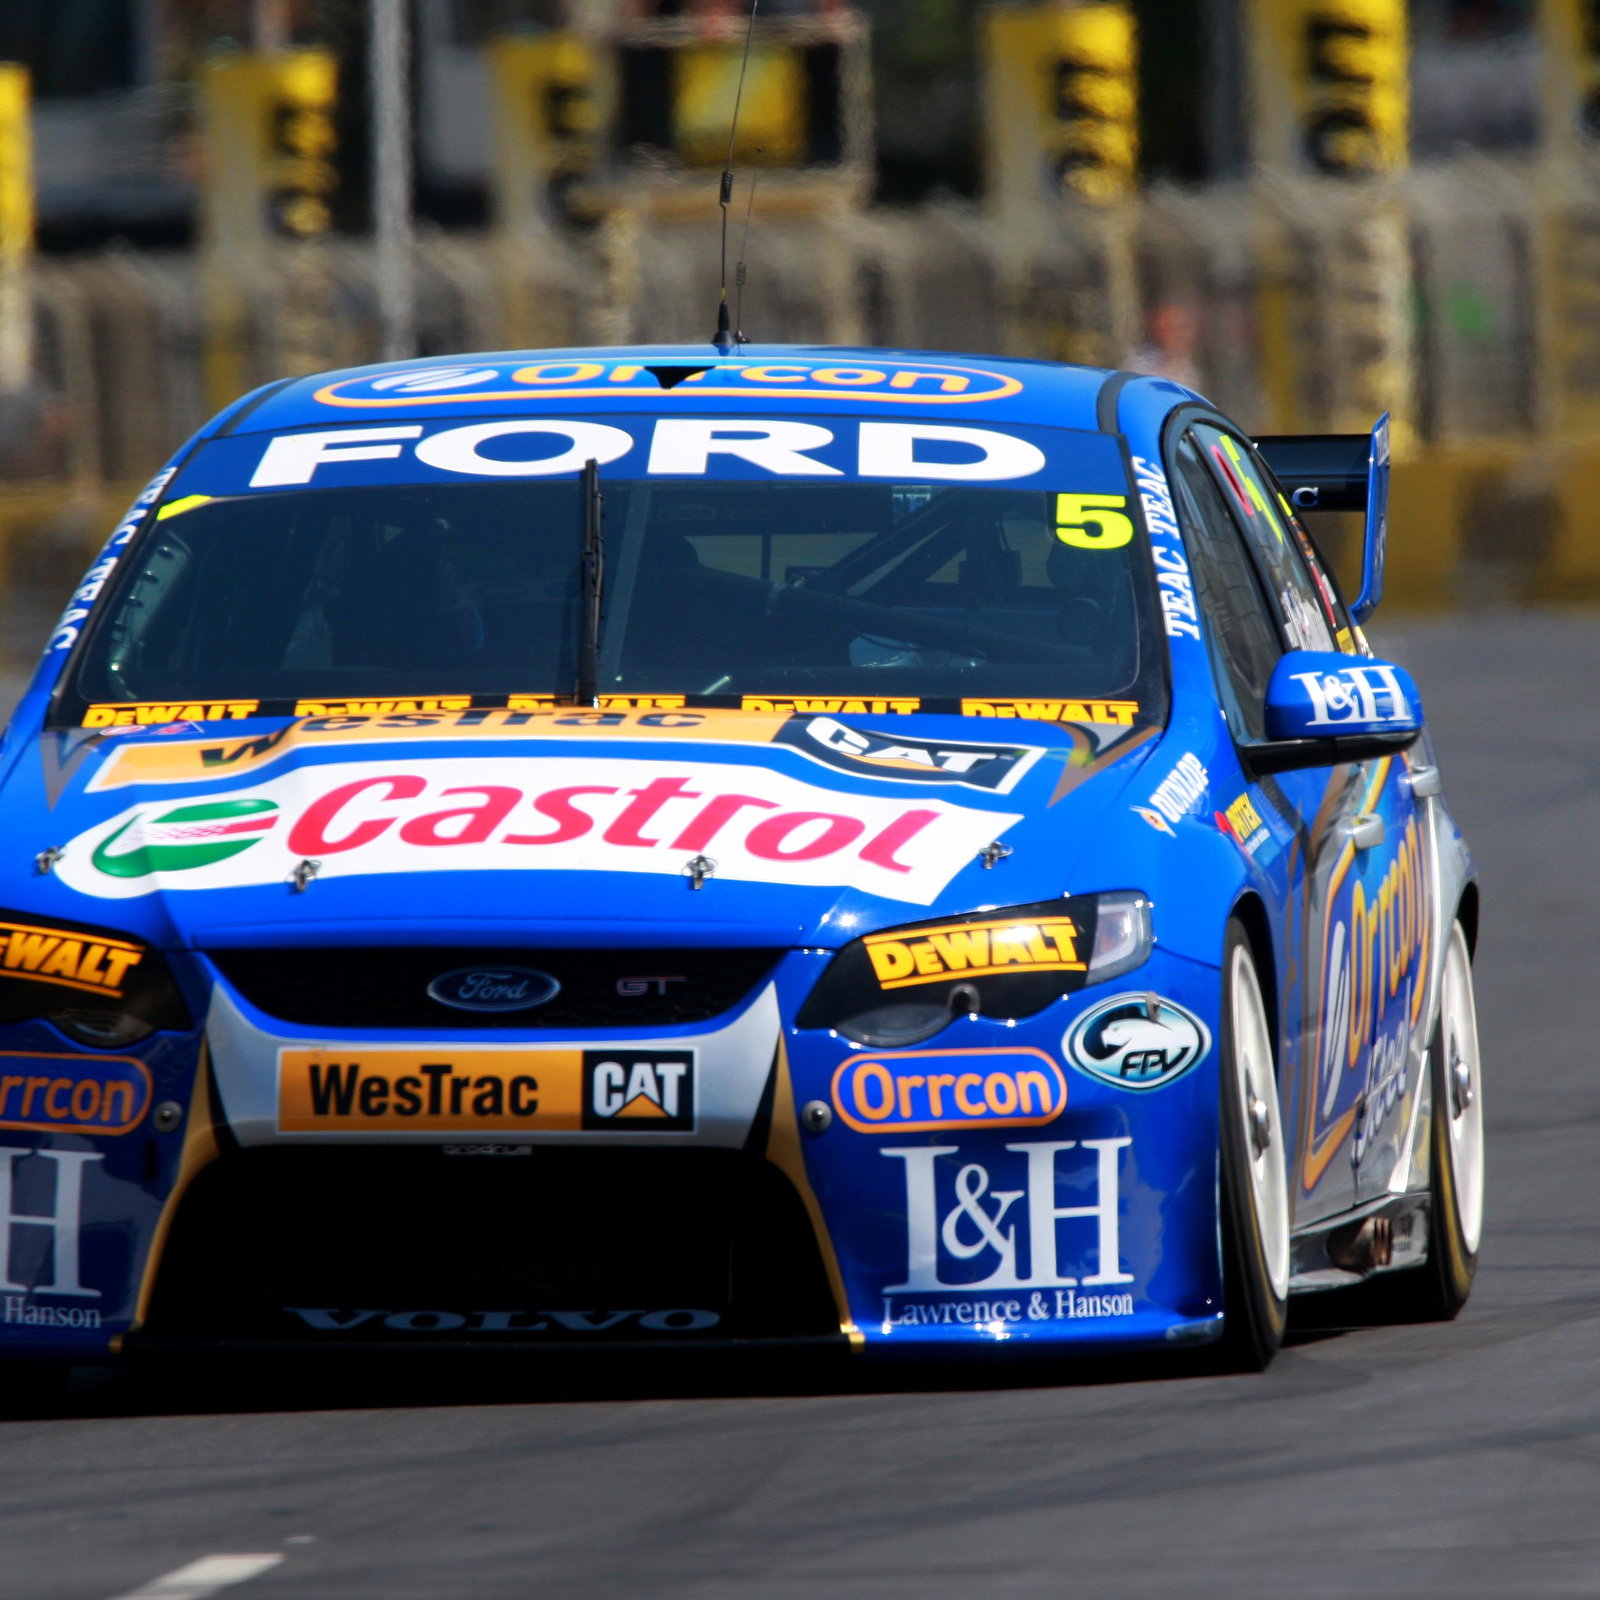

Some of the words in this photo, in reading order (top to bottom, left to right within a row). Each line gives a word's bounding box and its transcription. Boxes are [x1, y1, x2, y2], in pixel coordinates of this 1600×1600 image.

[250, 419, 1046, 486] FORD
[1056, 494, 1134, 549] 5
[1131, 456, 1181, 540] TEAC
[1151, 546, 1200, 641] TEAC
[1289, 665, 1412, 727] L&H
[806, 716, 996, 772] CAT
[287, 774, 942, 874] Castrol
[0, 932, 144, 988] WALT
[866, 925, 1078, 982] DEWALT
[458, 972, 528, 1001] Ford
[616, 976, 688, 996] GT
[309, 1064, 539, 1117] WesTrac
[593, 1062, 687, 1117] CAT
[1120, 1048, 1191, 1077] FPV
[852, 1062, 1052, 1121] Orrcon
[880, 1137, 1134, 1294] L&H
[4, 1296, 101, 1328] Hanson
[284, 1308, 720, 1331] VOLVO
[882, 1297, 1021, 1328] Lawrence
[1027, 1292, 1050, 1321] &
[1055, 1288, 1134, 1320] Hanson
